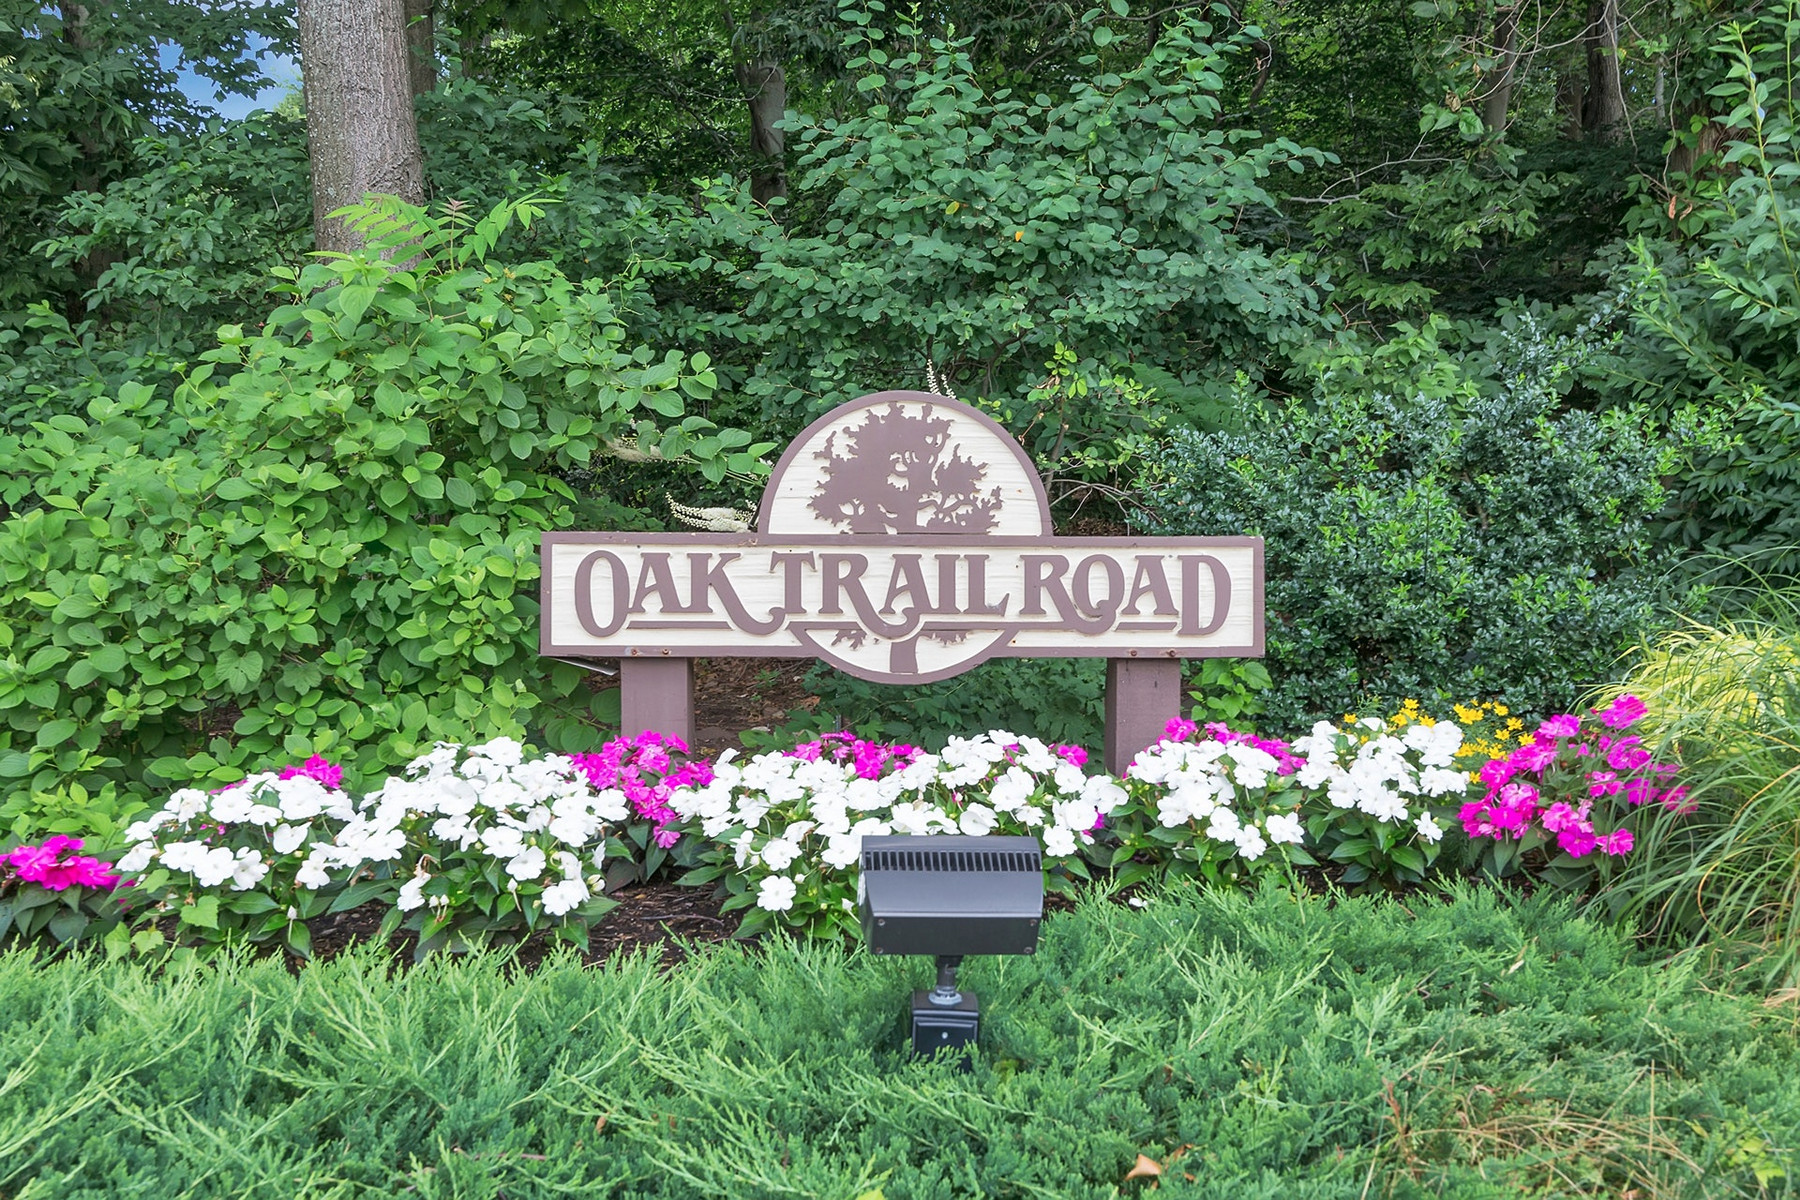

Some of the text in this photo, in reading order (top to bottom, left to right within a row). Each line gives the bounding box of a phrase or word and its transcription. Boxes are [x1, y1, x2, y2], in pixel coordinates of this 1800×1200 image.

[574, 549, 1232, 639] OAK TRAIL ROAD
